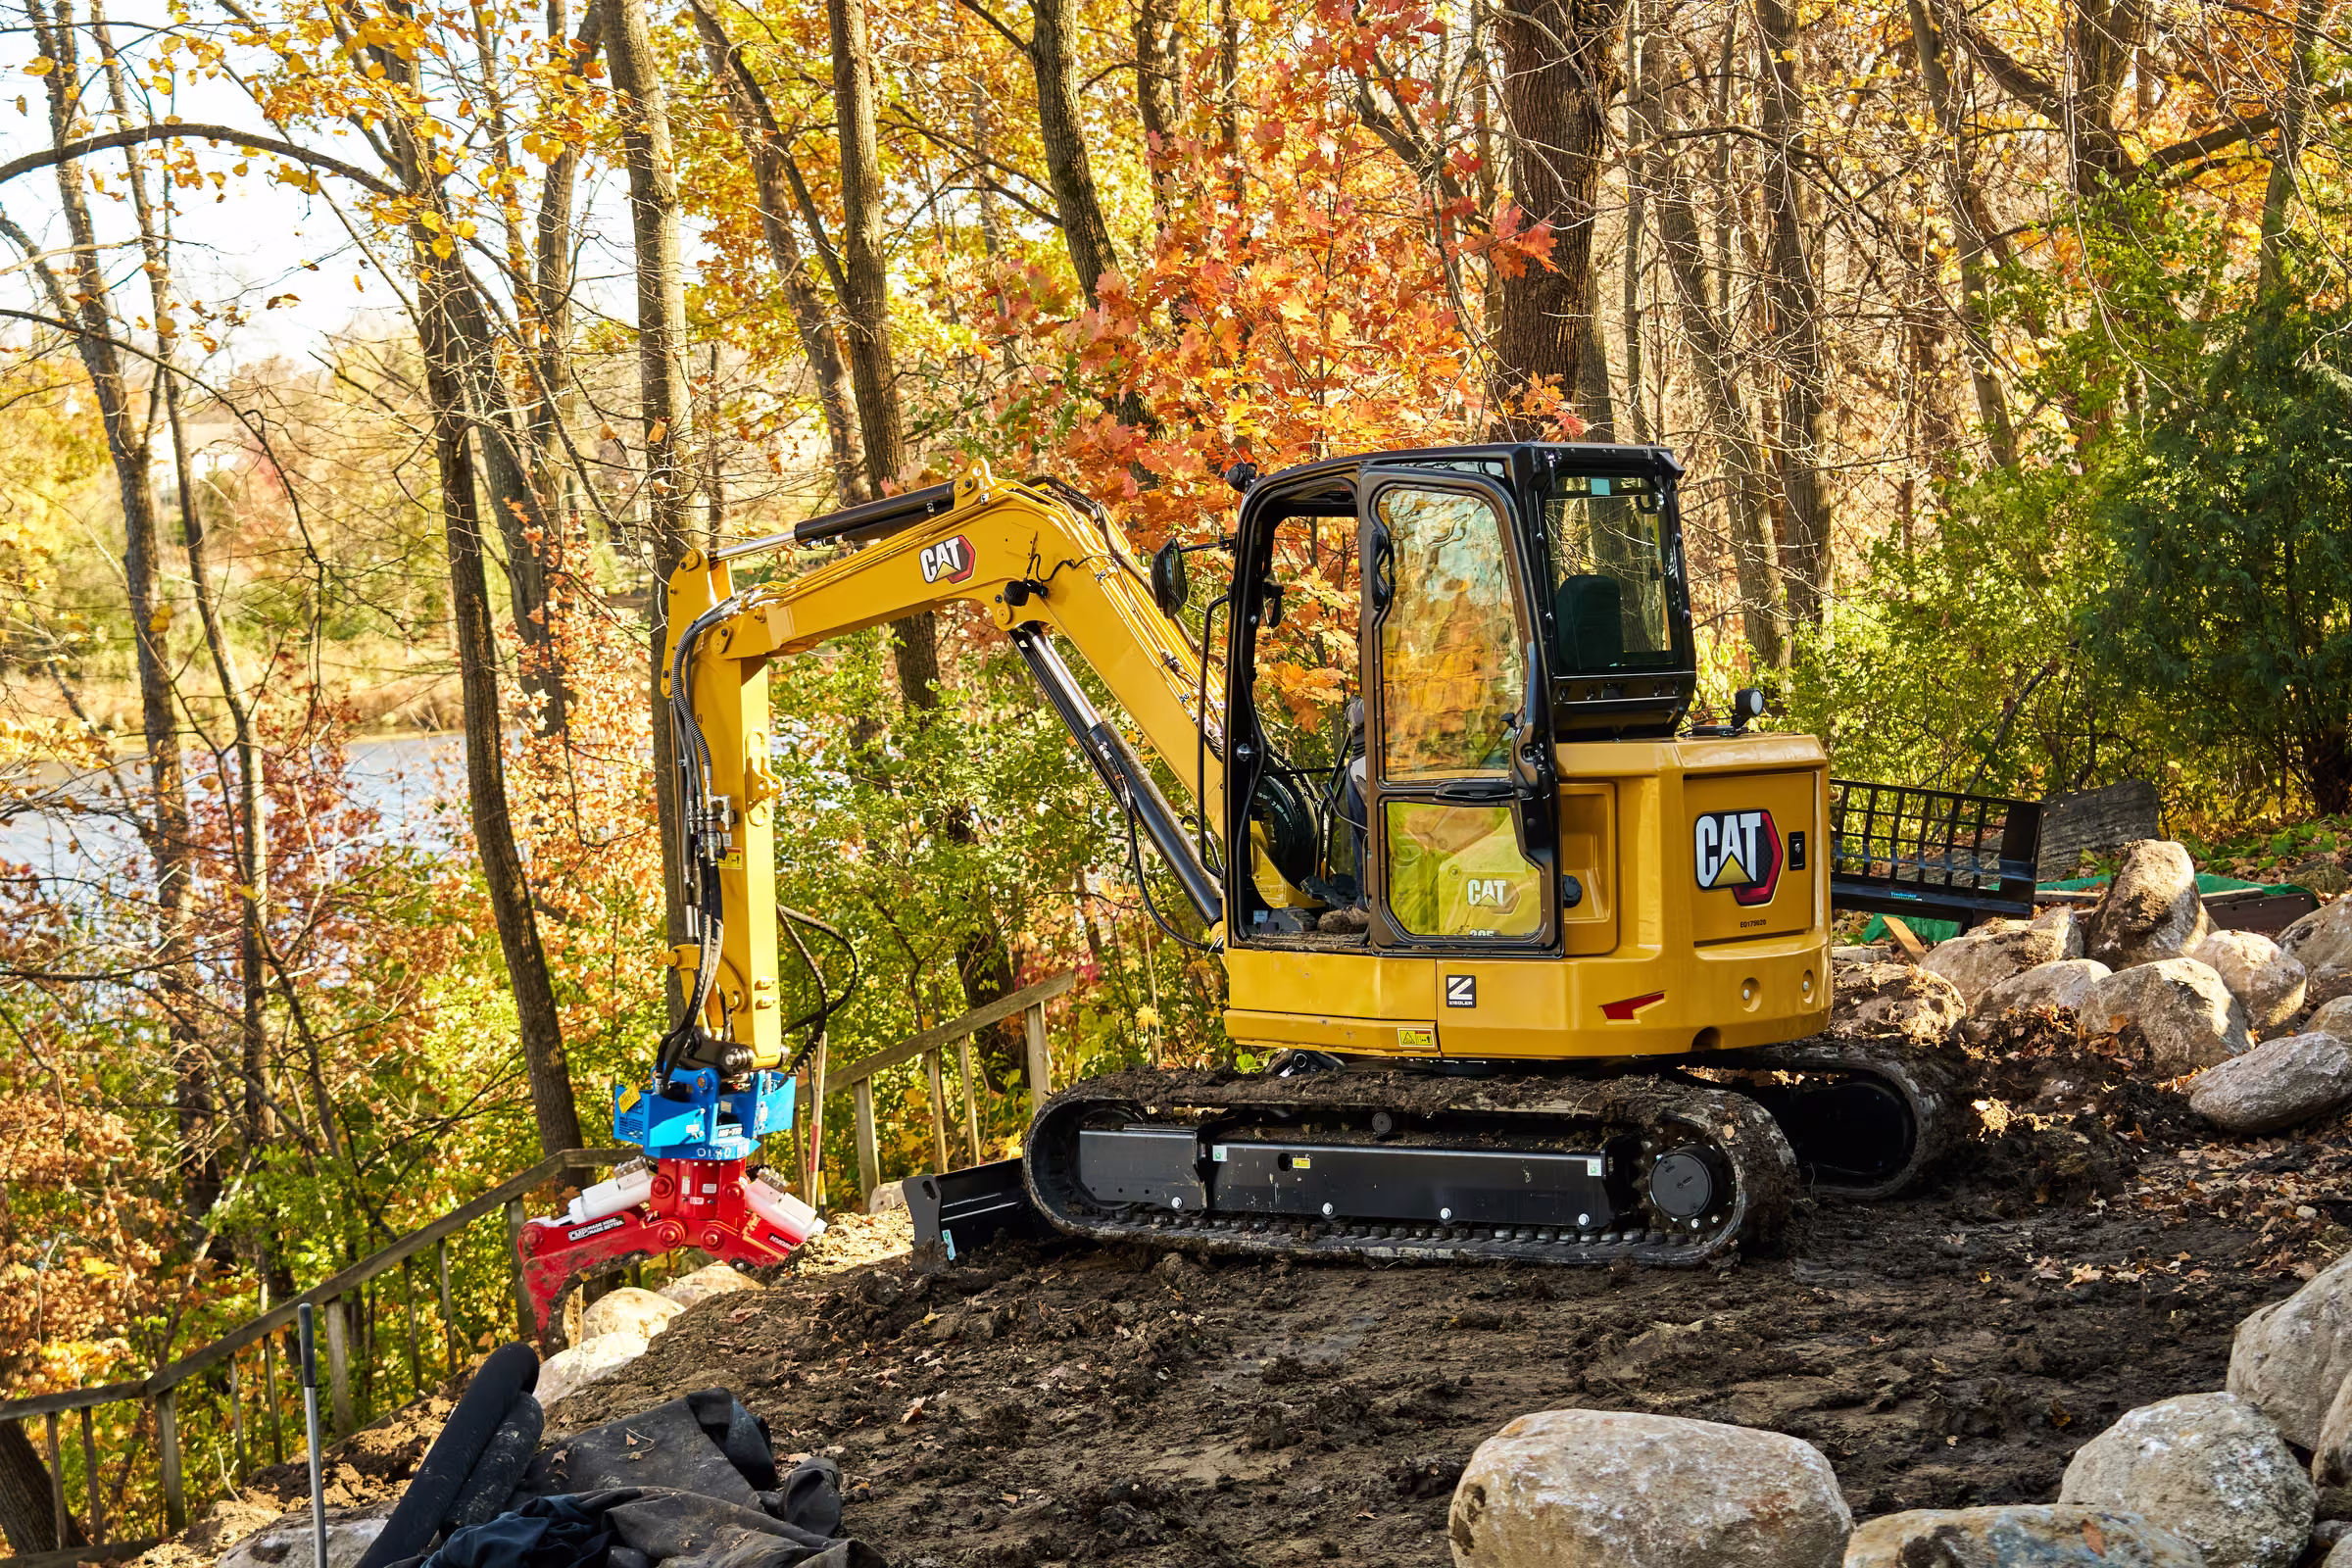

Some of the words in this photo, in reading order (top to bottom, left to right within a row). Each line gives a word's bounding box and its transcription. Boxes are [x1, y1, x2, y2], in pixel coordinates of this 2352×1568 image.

[920, 536, 961, 583] CAT
[1695, 811, 1761, 887] CAT
[1467, 879, 1506, 906] CAT
[569, 1227, 589, 1241] CMP
[588, 1221, 603, 1230] MADE
[589, 1226, 604, 1235] MADE
